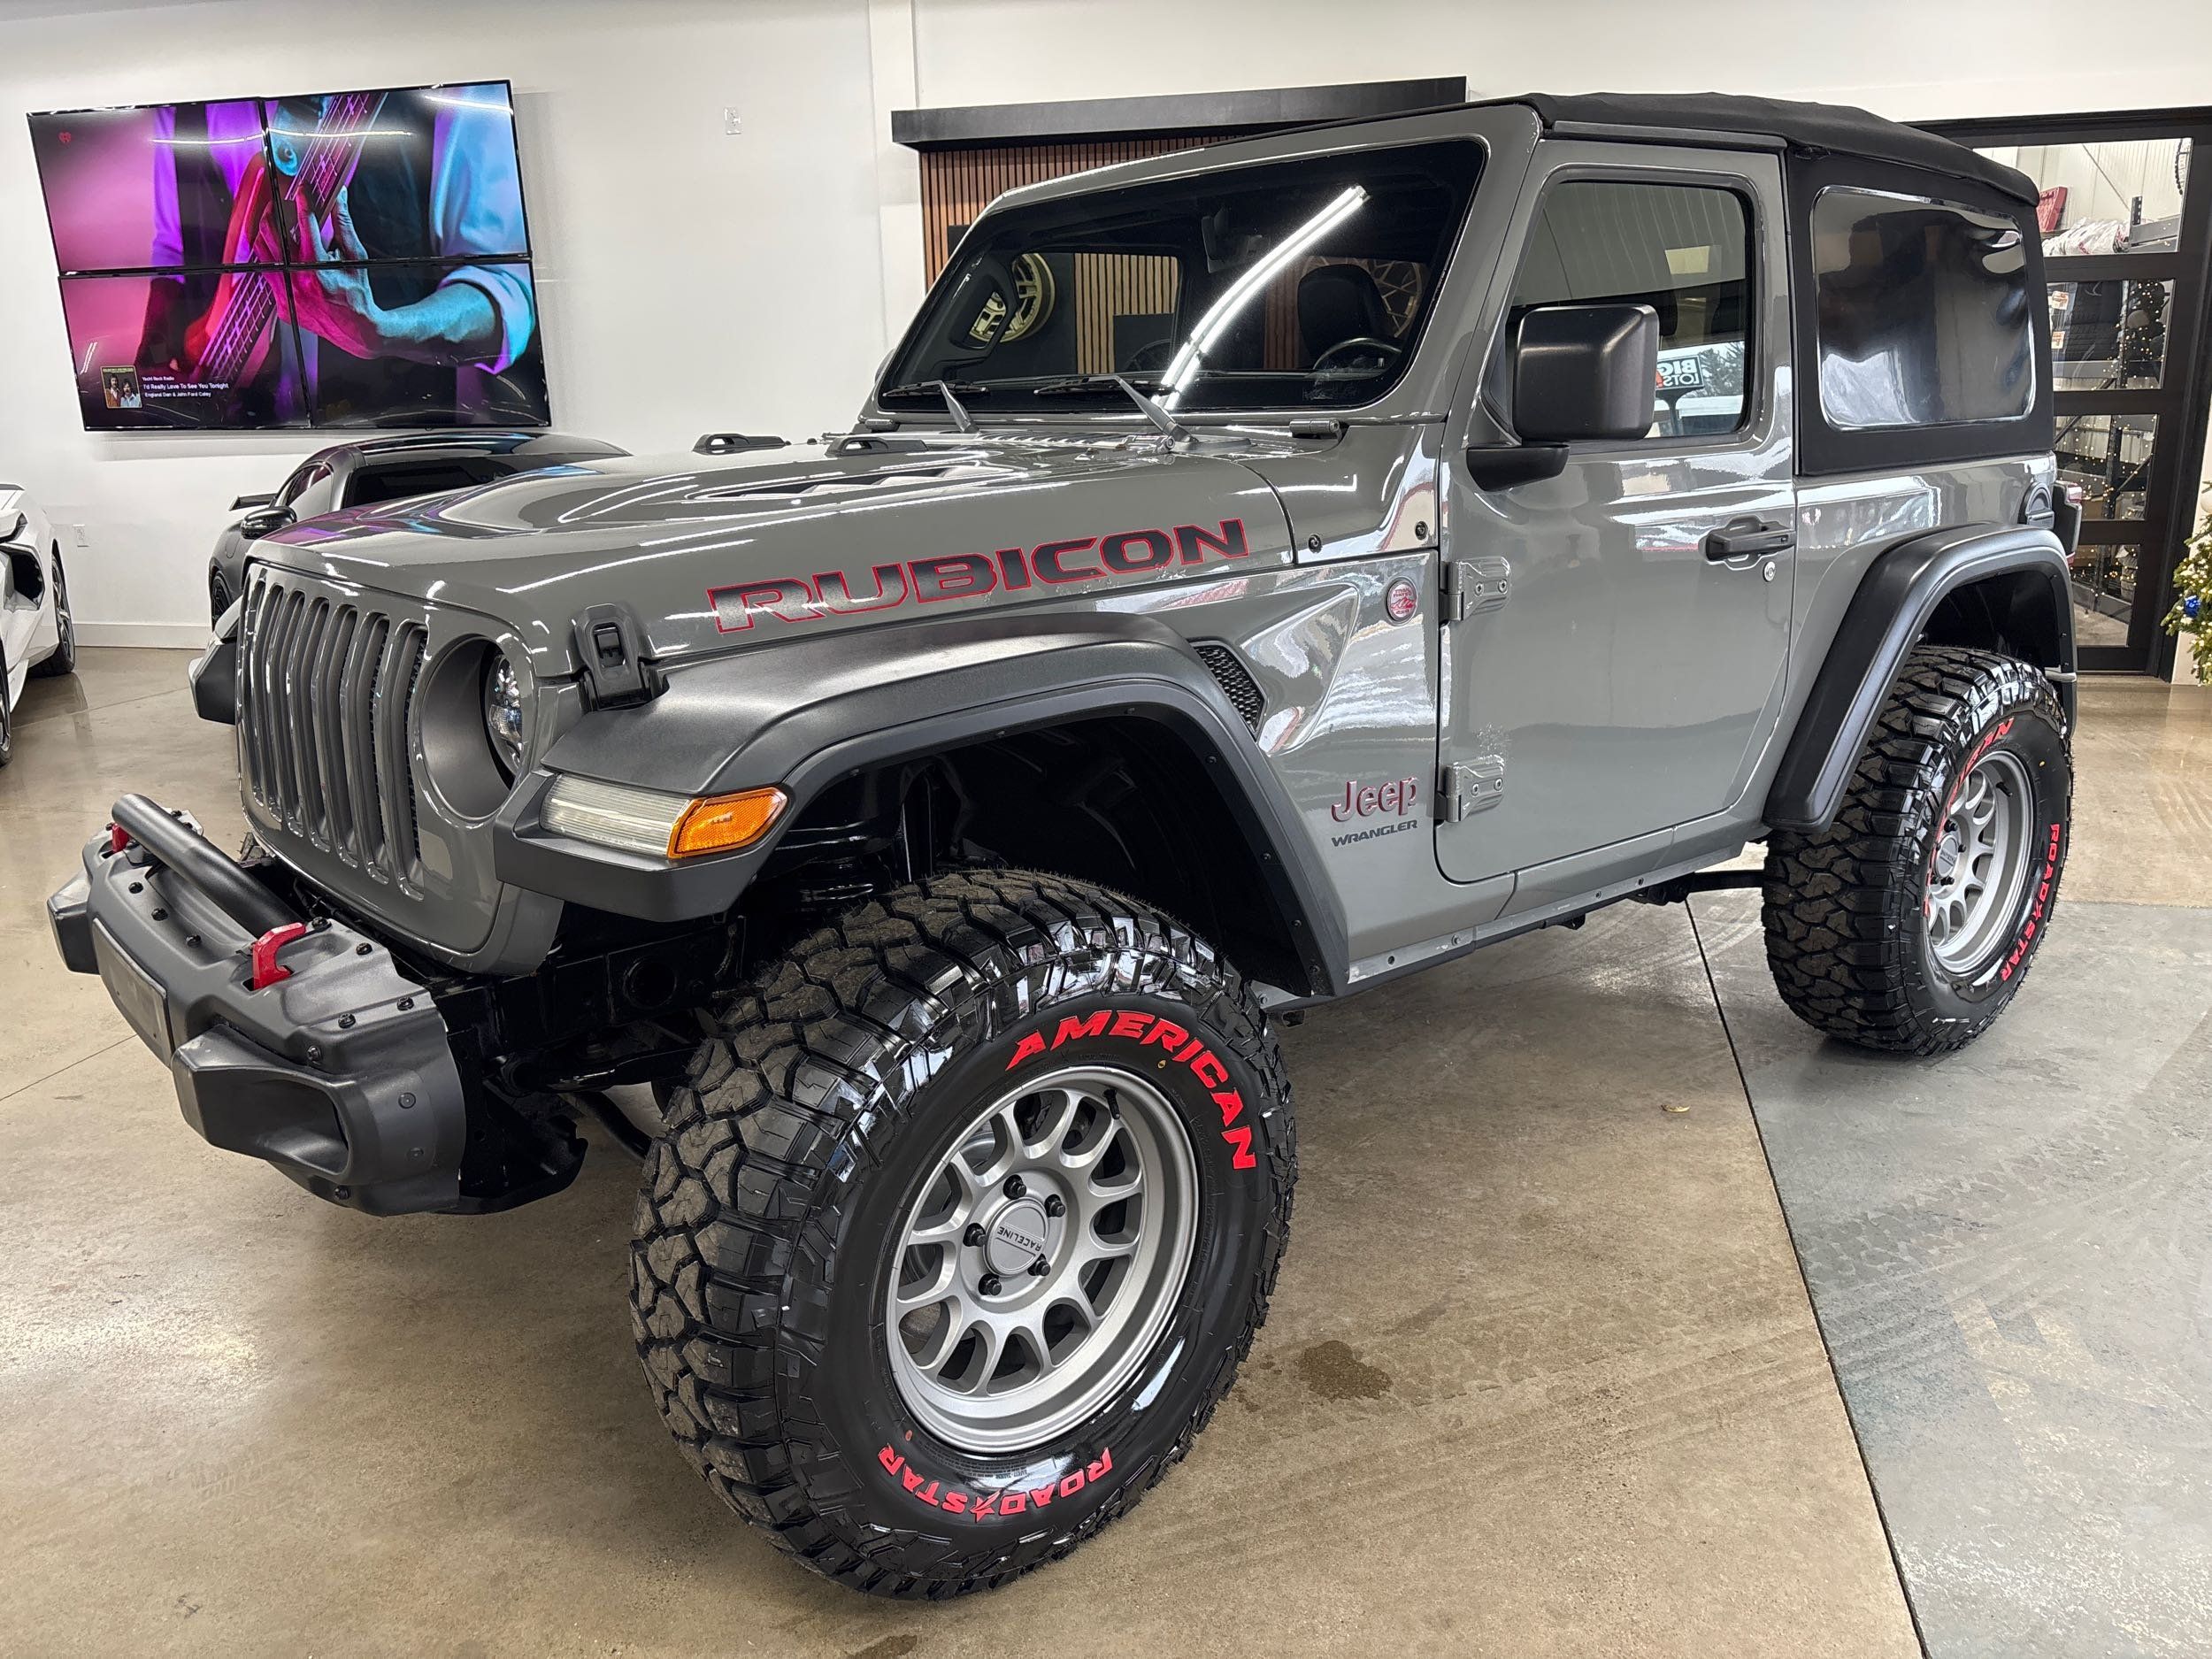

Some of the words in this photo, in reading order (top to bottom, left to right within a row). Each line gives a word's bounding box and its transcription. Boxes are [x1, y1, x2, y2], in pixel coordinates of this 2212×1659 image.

[707, 518, 1249, 634] RUBICON
[1332, 776, 1417, 822] Jeep
[1332, 820, 1417, 847] WRANGLER
[1005, 1010, 1256, 1169] AMERICAN
[997, 1226, 1042, 1252] RACELINE
